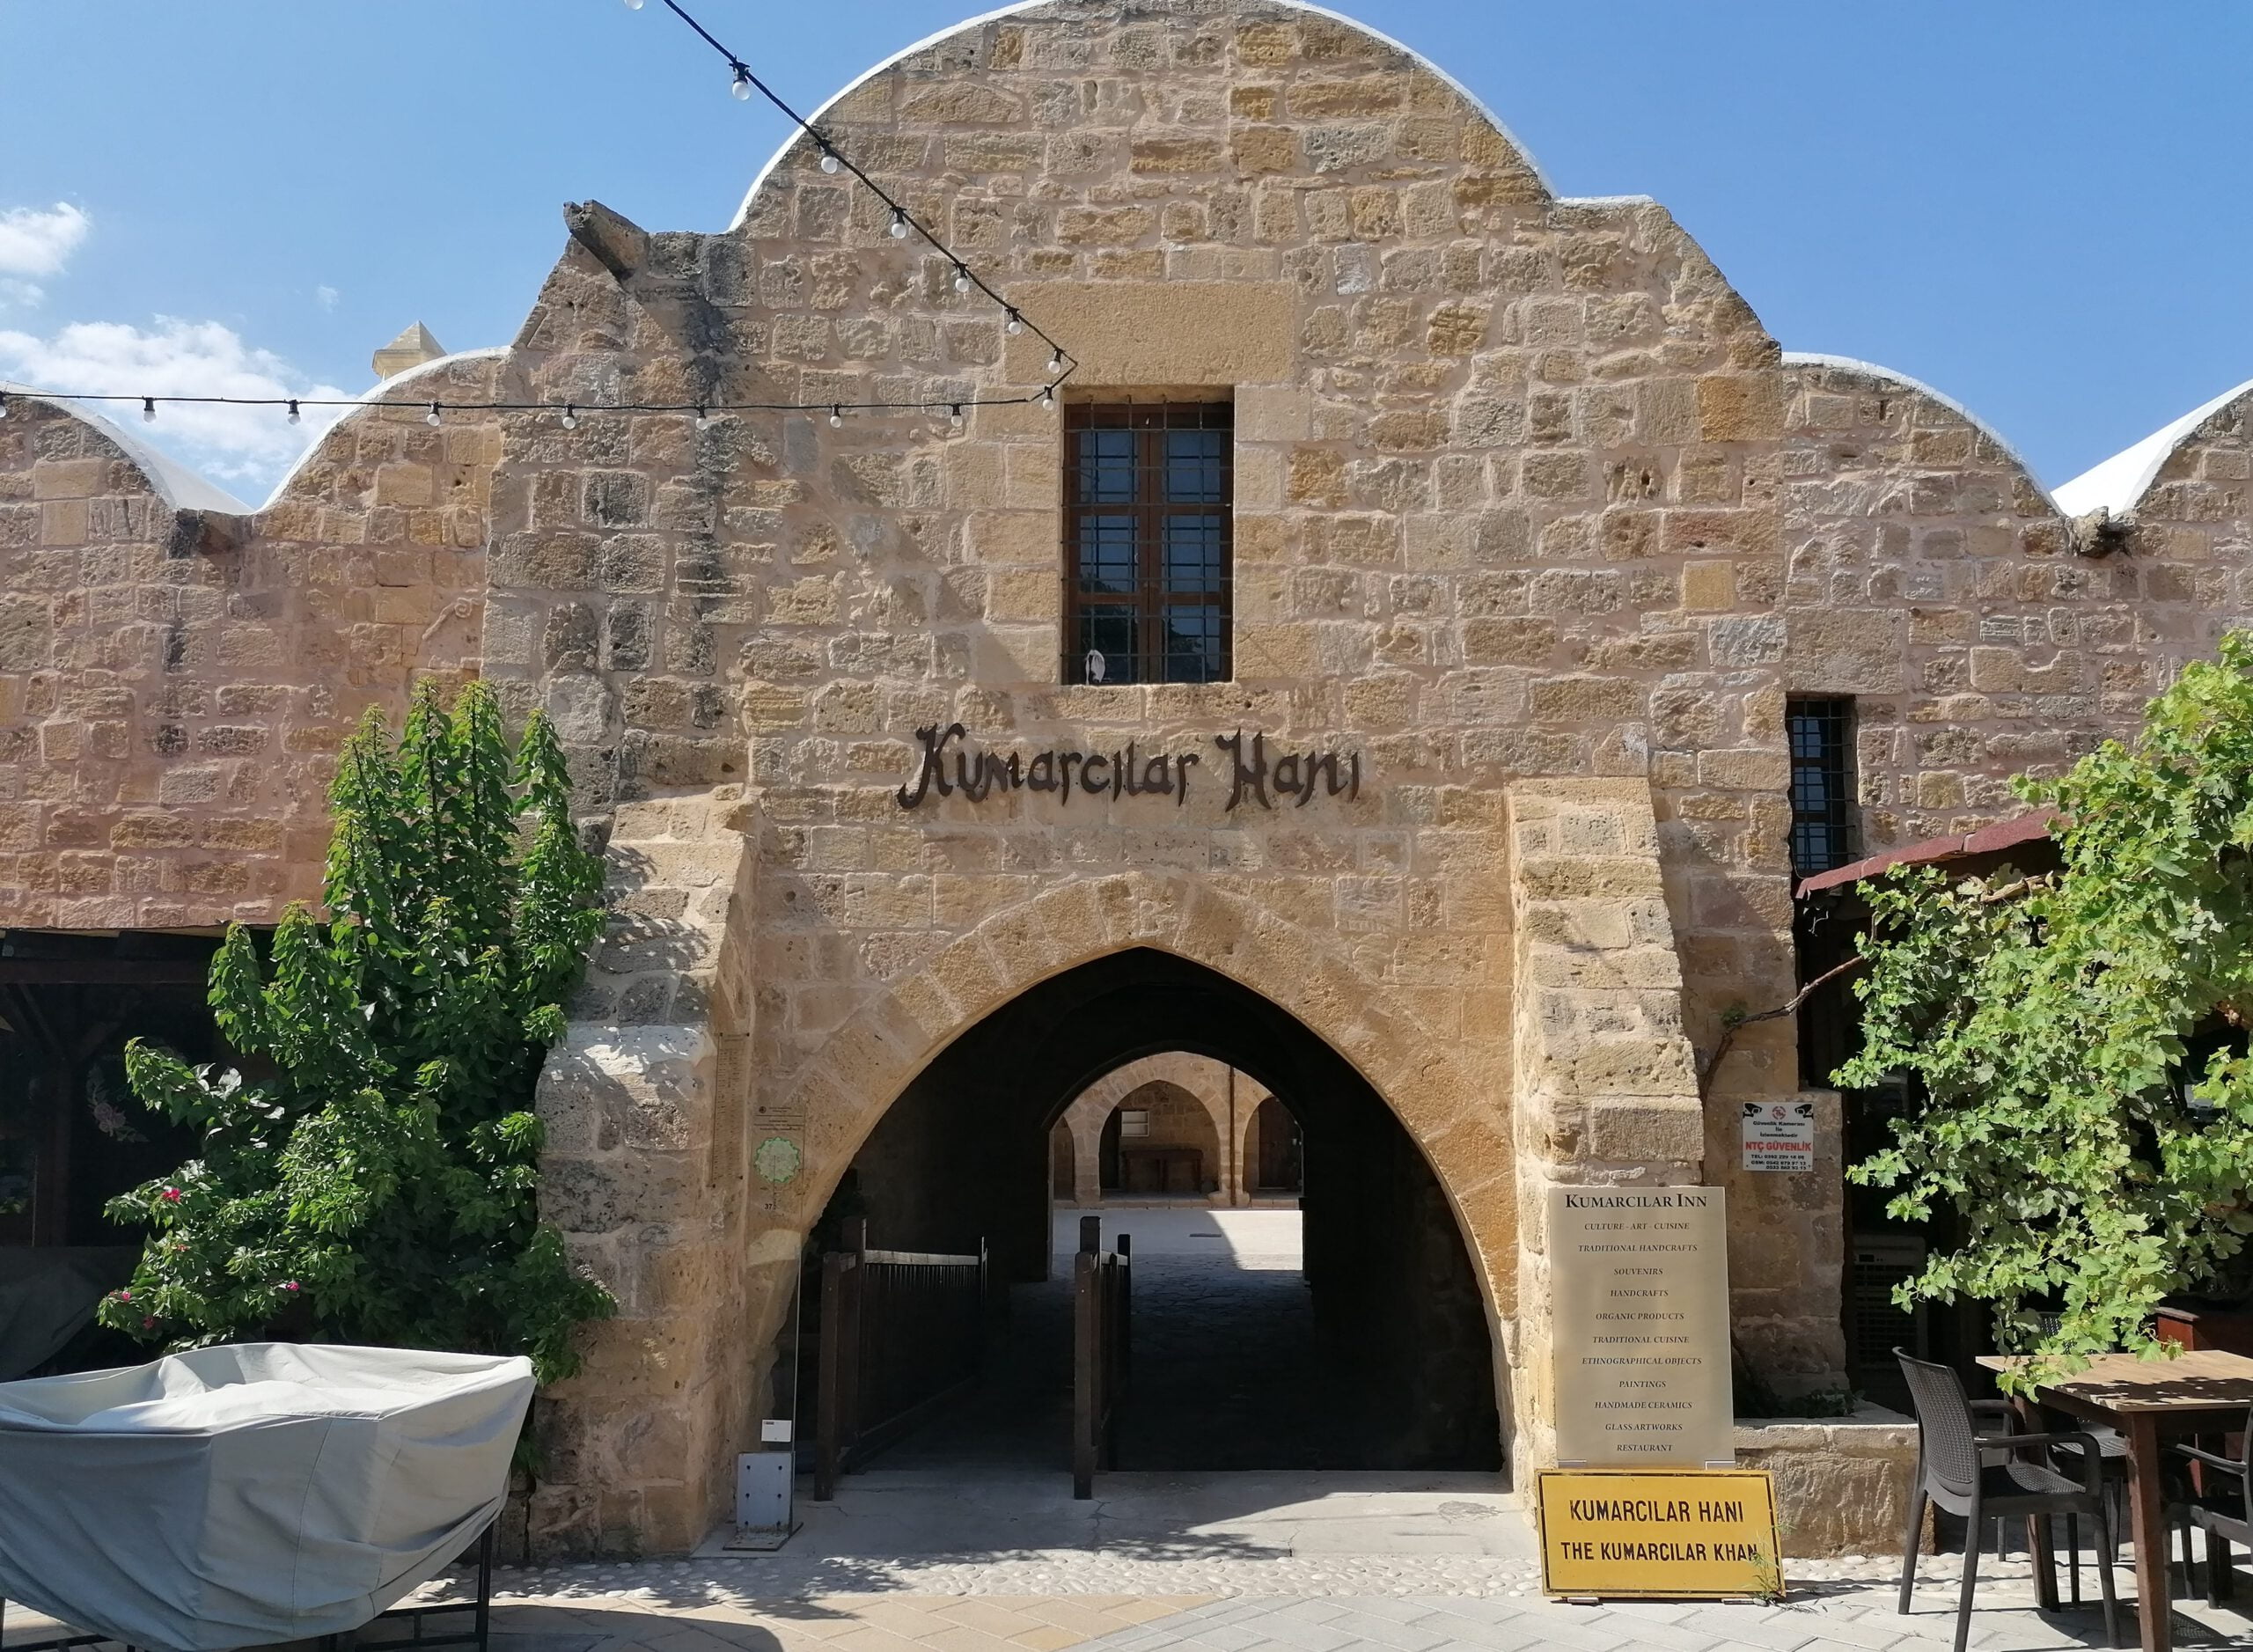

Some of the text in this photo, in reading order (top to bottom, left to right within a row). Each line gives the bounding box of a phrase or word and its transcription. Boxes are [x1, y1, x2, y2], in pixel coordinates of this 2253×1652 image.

[897, 722, 1360, 813] Kumarcılar Hanı
[1745, 1141, 1811, 1153] NTÇ GÜVENLİK
[1565, 1193, 1708, 1208] KUMARCILAR INN
[1664, 1357, 1702, 1366] OBJECTS
[1617, 1443, 1673, 1452] RESTAURANT
[1569, 1500, 1743, 1523] KUMARCILAR HANI
[1560, 1542, 1758, 1562] THE KUMARCILAR KHAN
